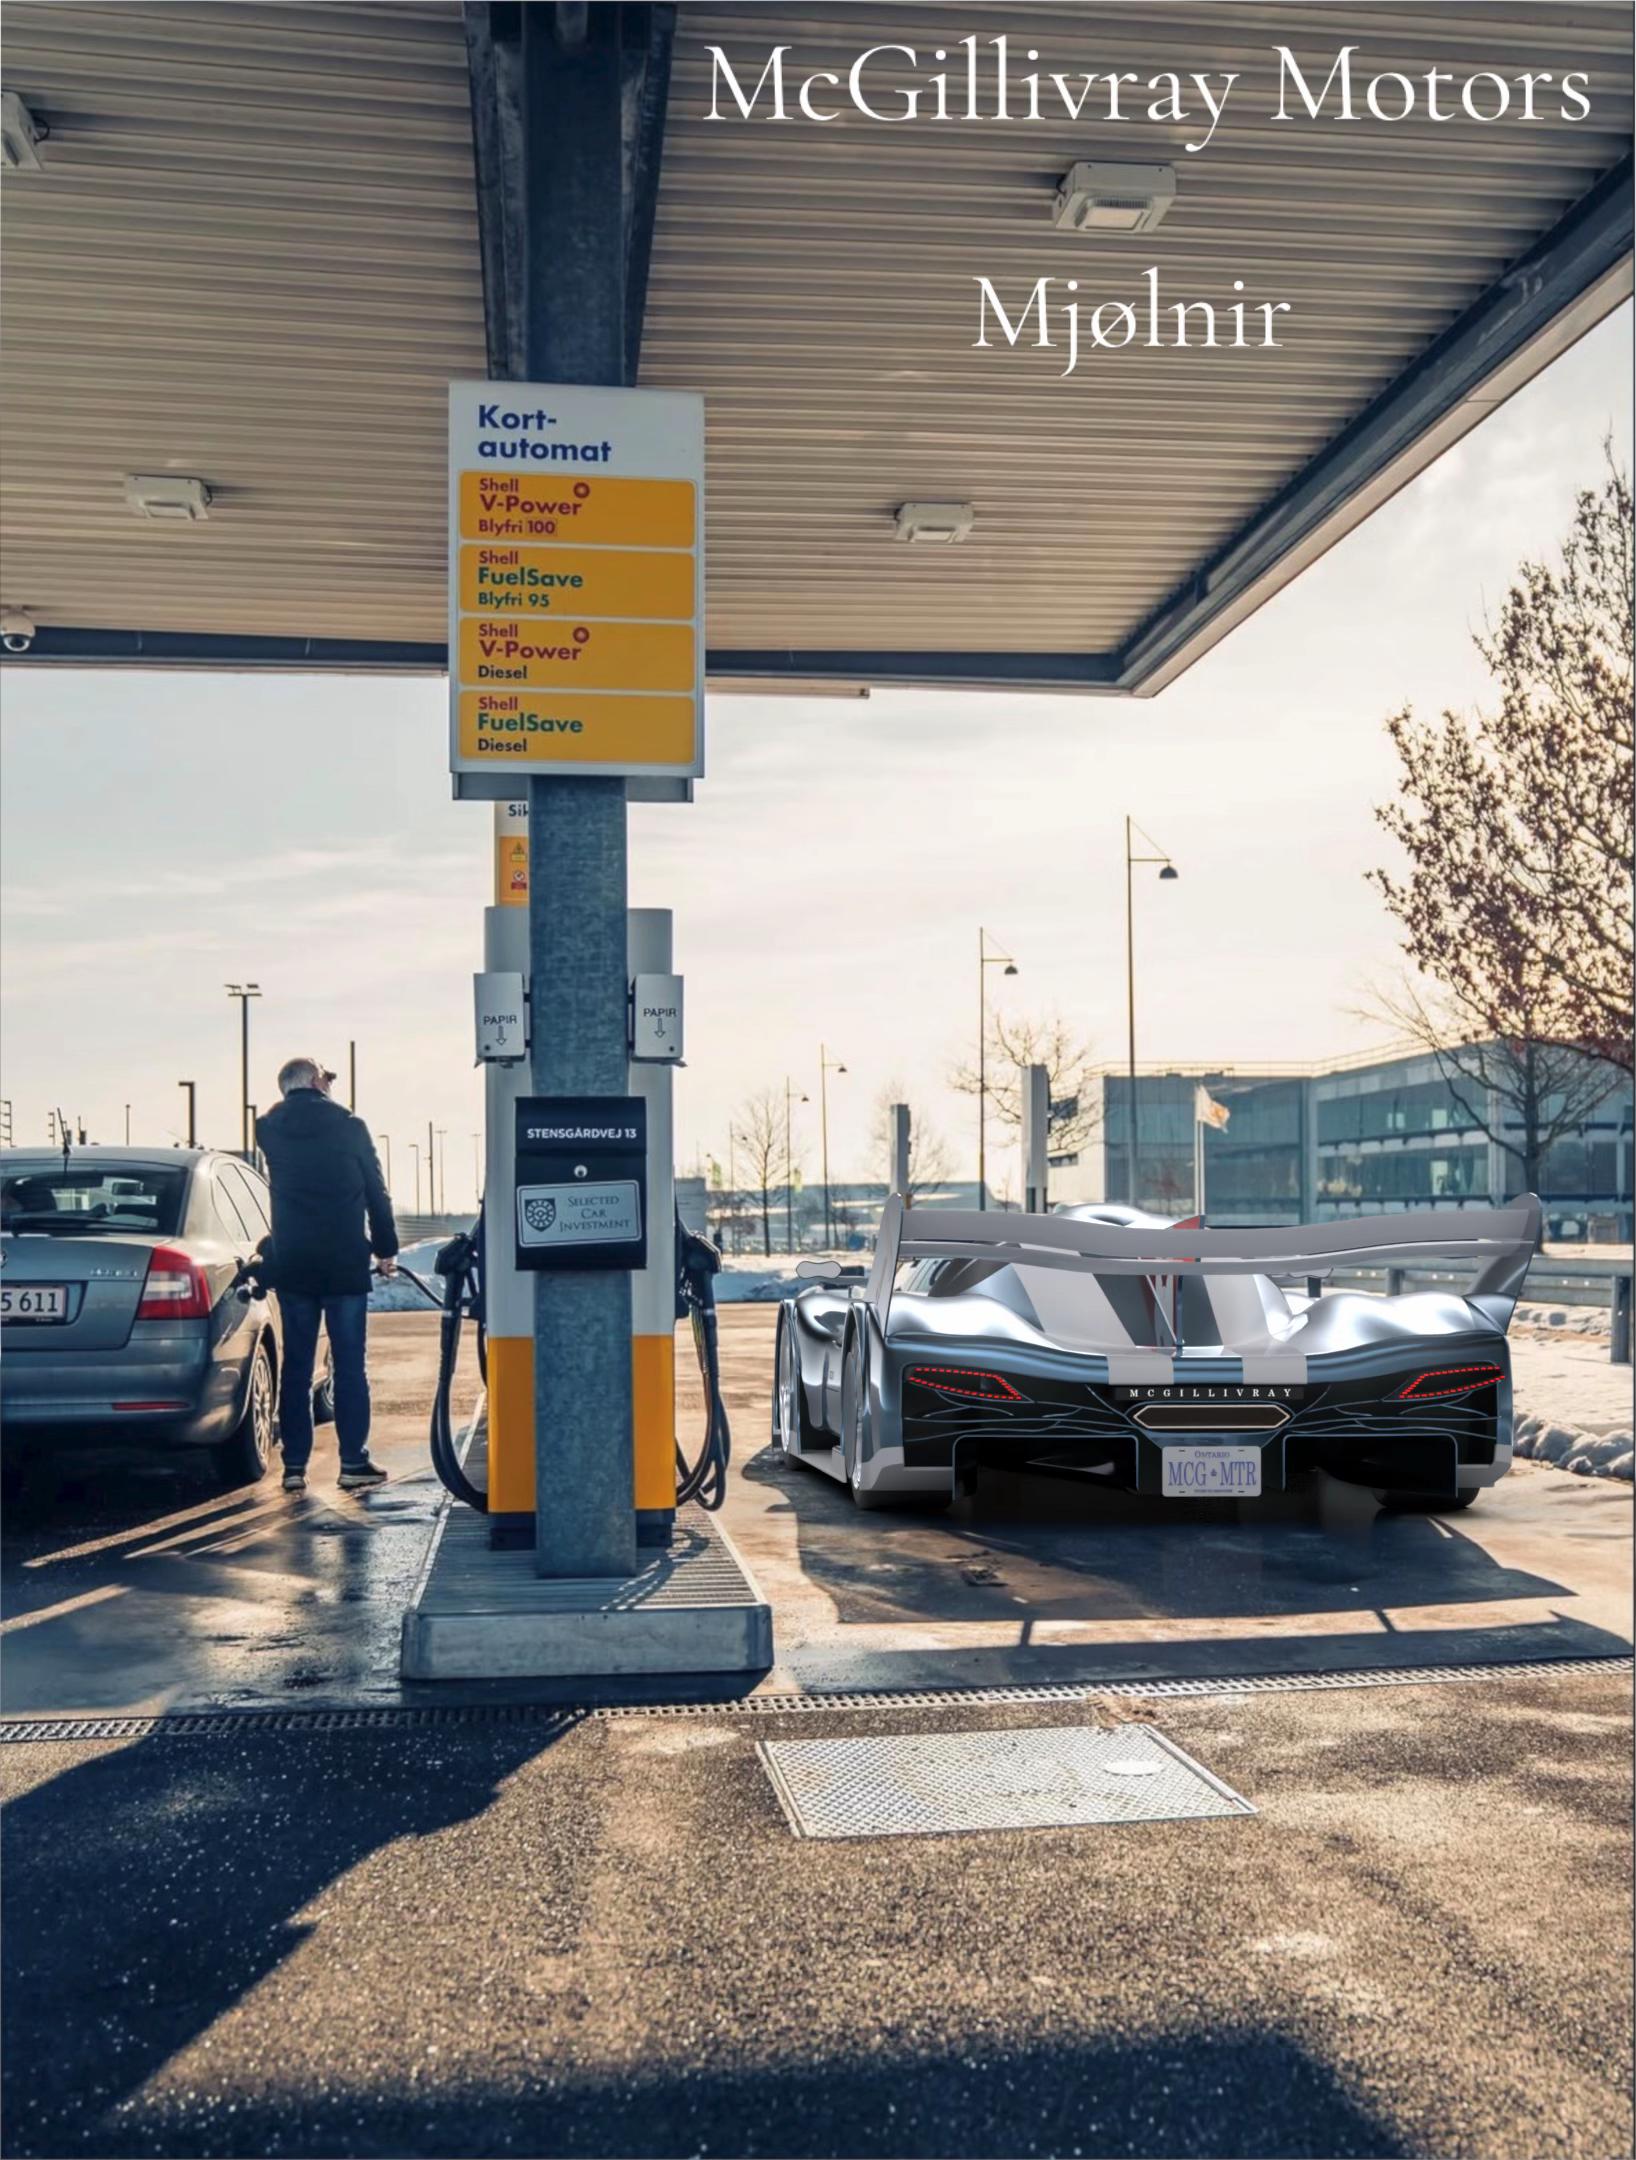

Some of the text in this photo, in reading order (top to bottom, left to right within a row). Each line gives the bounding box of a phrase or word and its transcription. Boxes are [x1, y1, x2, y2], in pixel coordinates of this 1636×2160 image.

[478, 404, 557, 431] Kort-
[477, 437, 612, 463] automat
[479, 478, 519, 493] Shell
[480, 493, 583, 517] V-Power
[478, 519, 556, 536] Blyfri 100
[479, 550, 519, 565] Shell
[478, 566, 583, 588] FuelSave
[478, 591, 550, 609] Blyfri 95
[479, 623, 519, 638] Shell
[480, 639, 582, 661] V-Power
[478, 664, 528, 680] Diesel
[479, 696, 519, 711] Shell
[478, 712, 583, 734] FuelSave
[477, 737, 528, 753] Diesel
[483, 1015, 517, 1026] PAPIR
[643, 1007, 677, 1018] PAPIR
[527, 1127, 637, 1139] STENSGÅRDVEJ 13
[19, 1291, 58, 1313] 611
[1129, 1388, 1292, 1398] MCGILLIVRAY
[1167, 1461, 1257, 1487] MCG MTR
